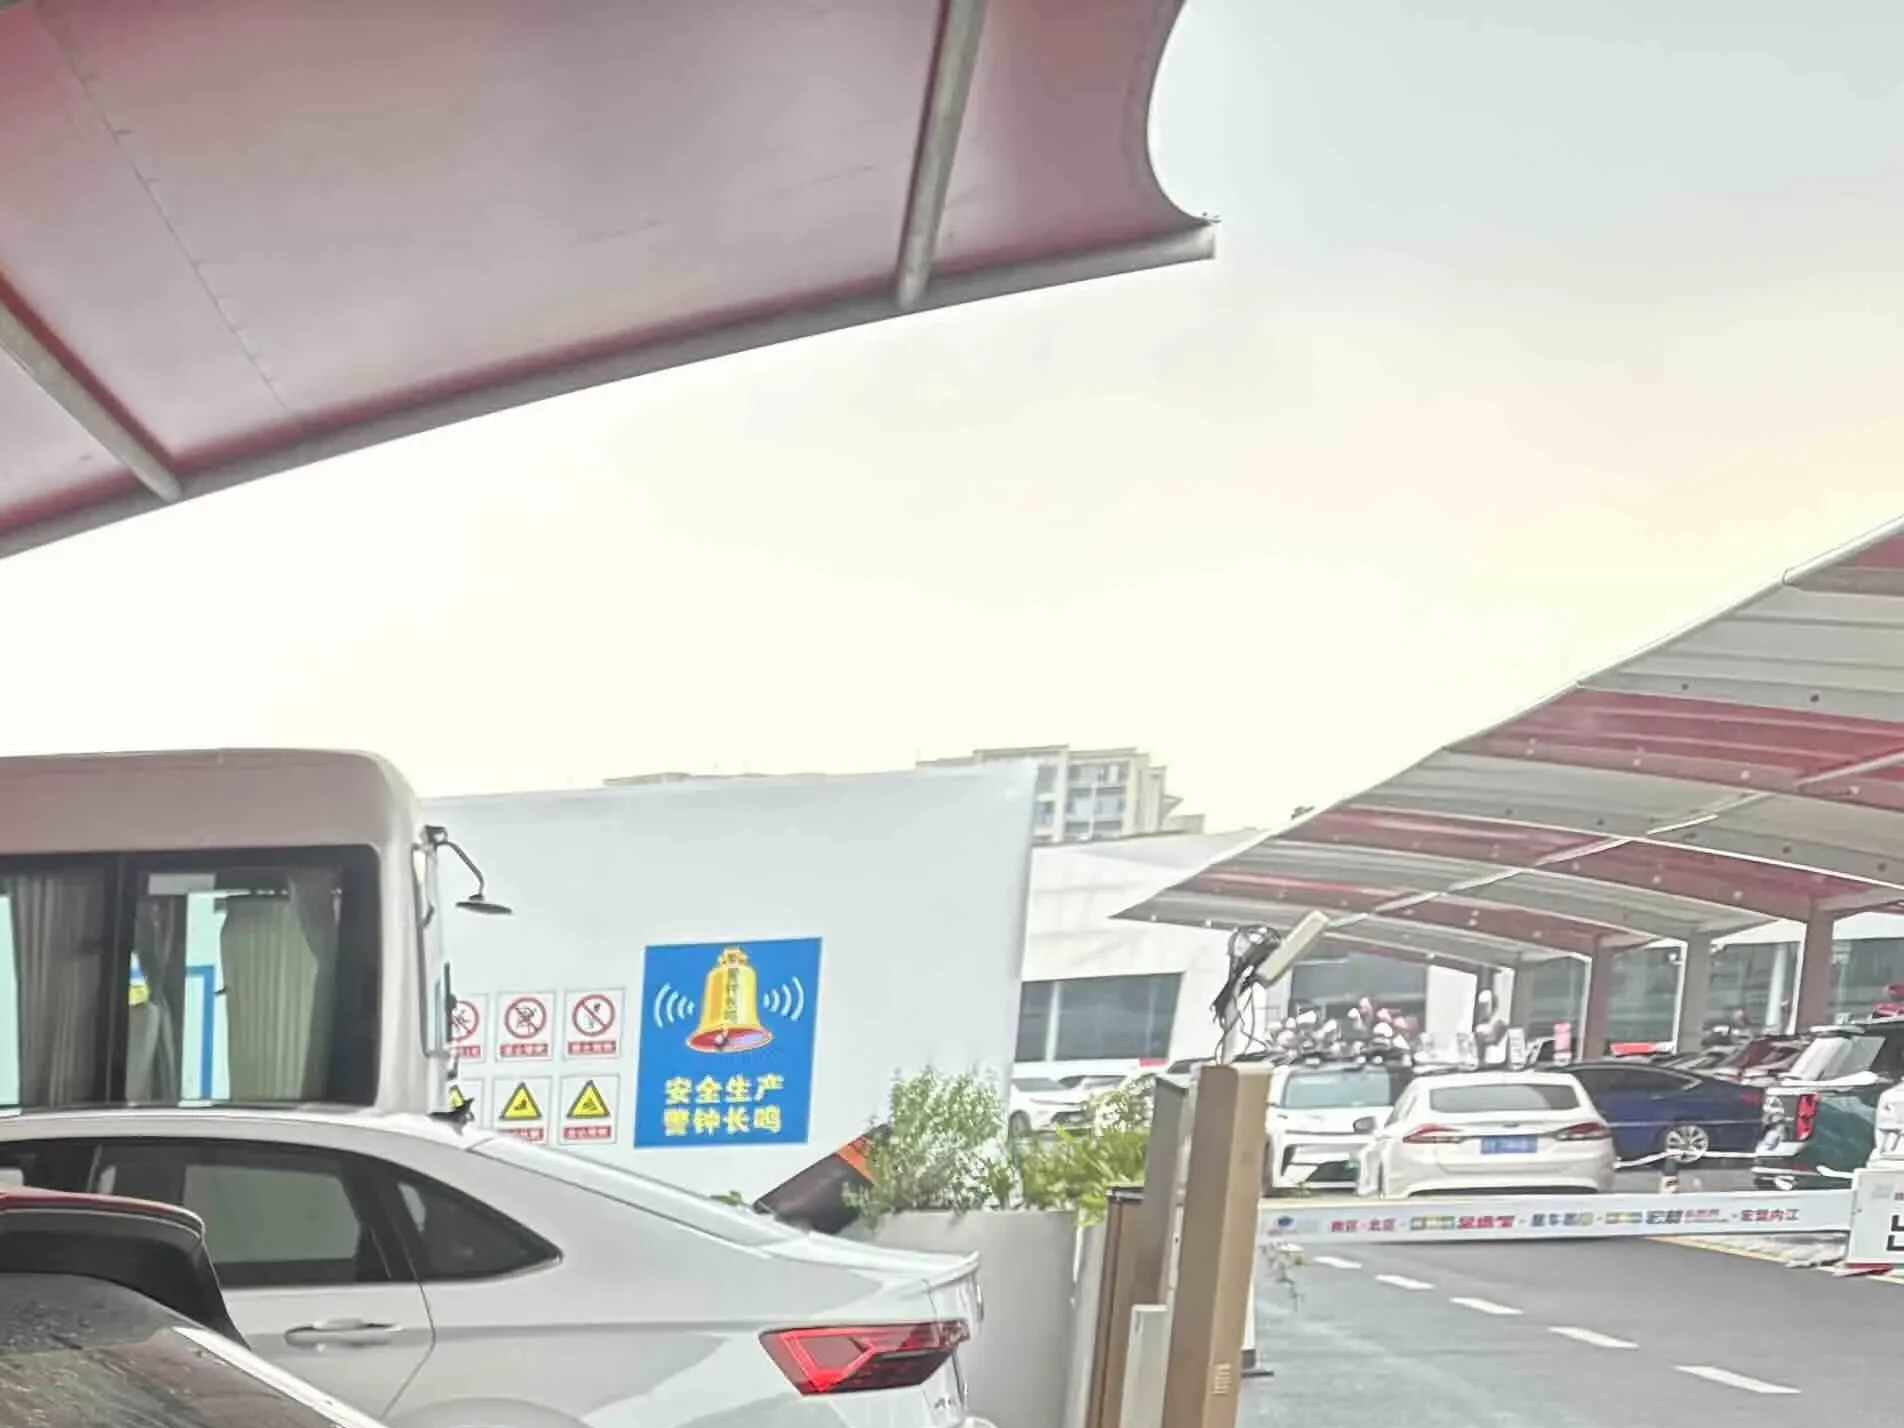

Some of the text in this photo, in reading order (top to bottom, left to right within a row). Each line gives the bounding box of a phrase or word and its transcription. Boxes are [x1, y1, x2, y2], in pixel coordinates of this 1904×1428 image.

[665, 1073, 784, 1104] 安全生产
[663, 1105, 782, 1136] 警钟长鸣
